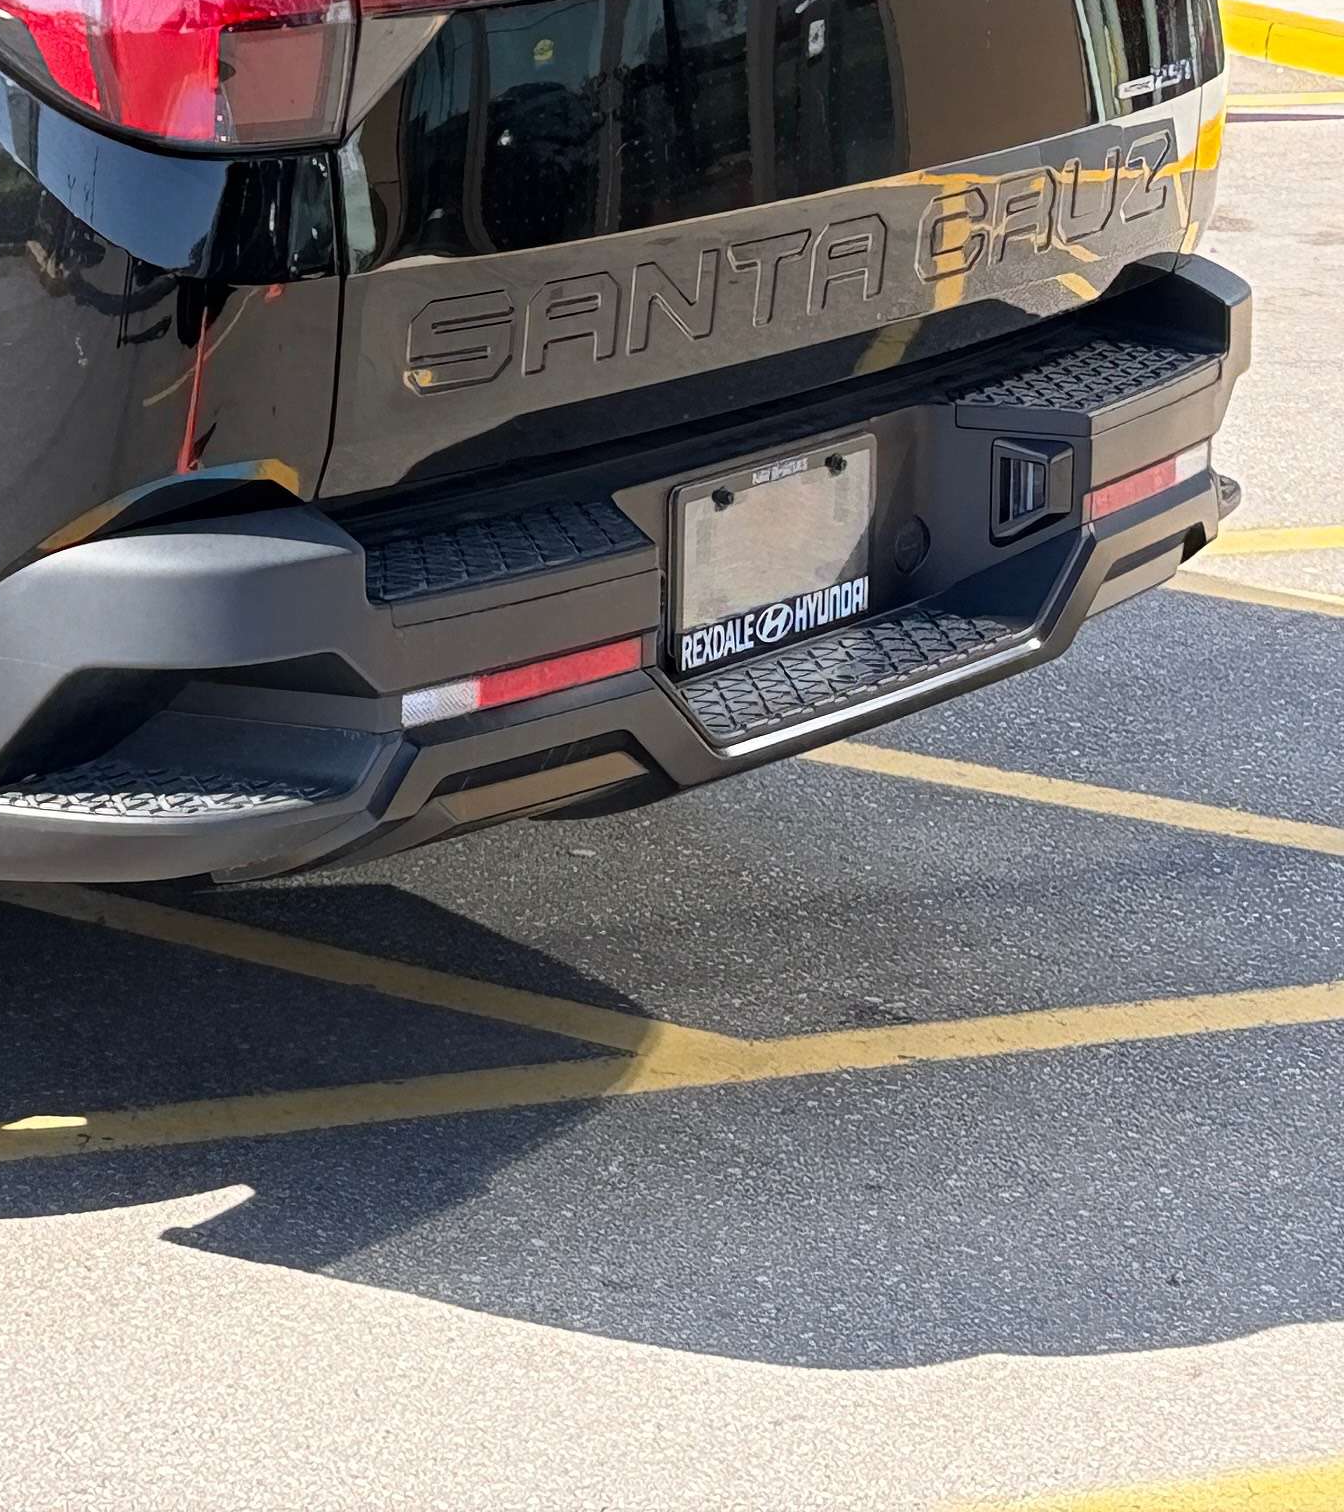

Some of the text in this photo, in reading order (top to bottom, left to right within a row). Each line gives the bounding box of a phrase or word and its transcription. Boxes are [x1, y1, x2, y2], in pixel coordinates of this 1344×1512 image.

[403, 129, 1174, 396] SANTA CRUZ
[681, 576, 870, 672] REXDALE HYUNDAI
